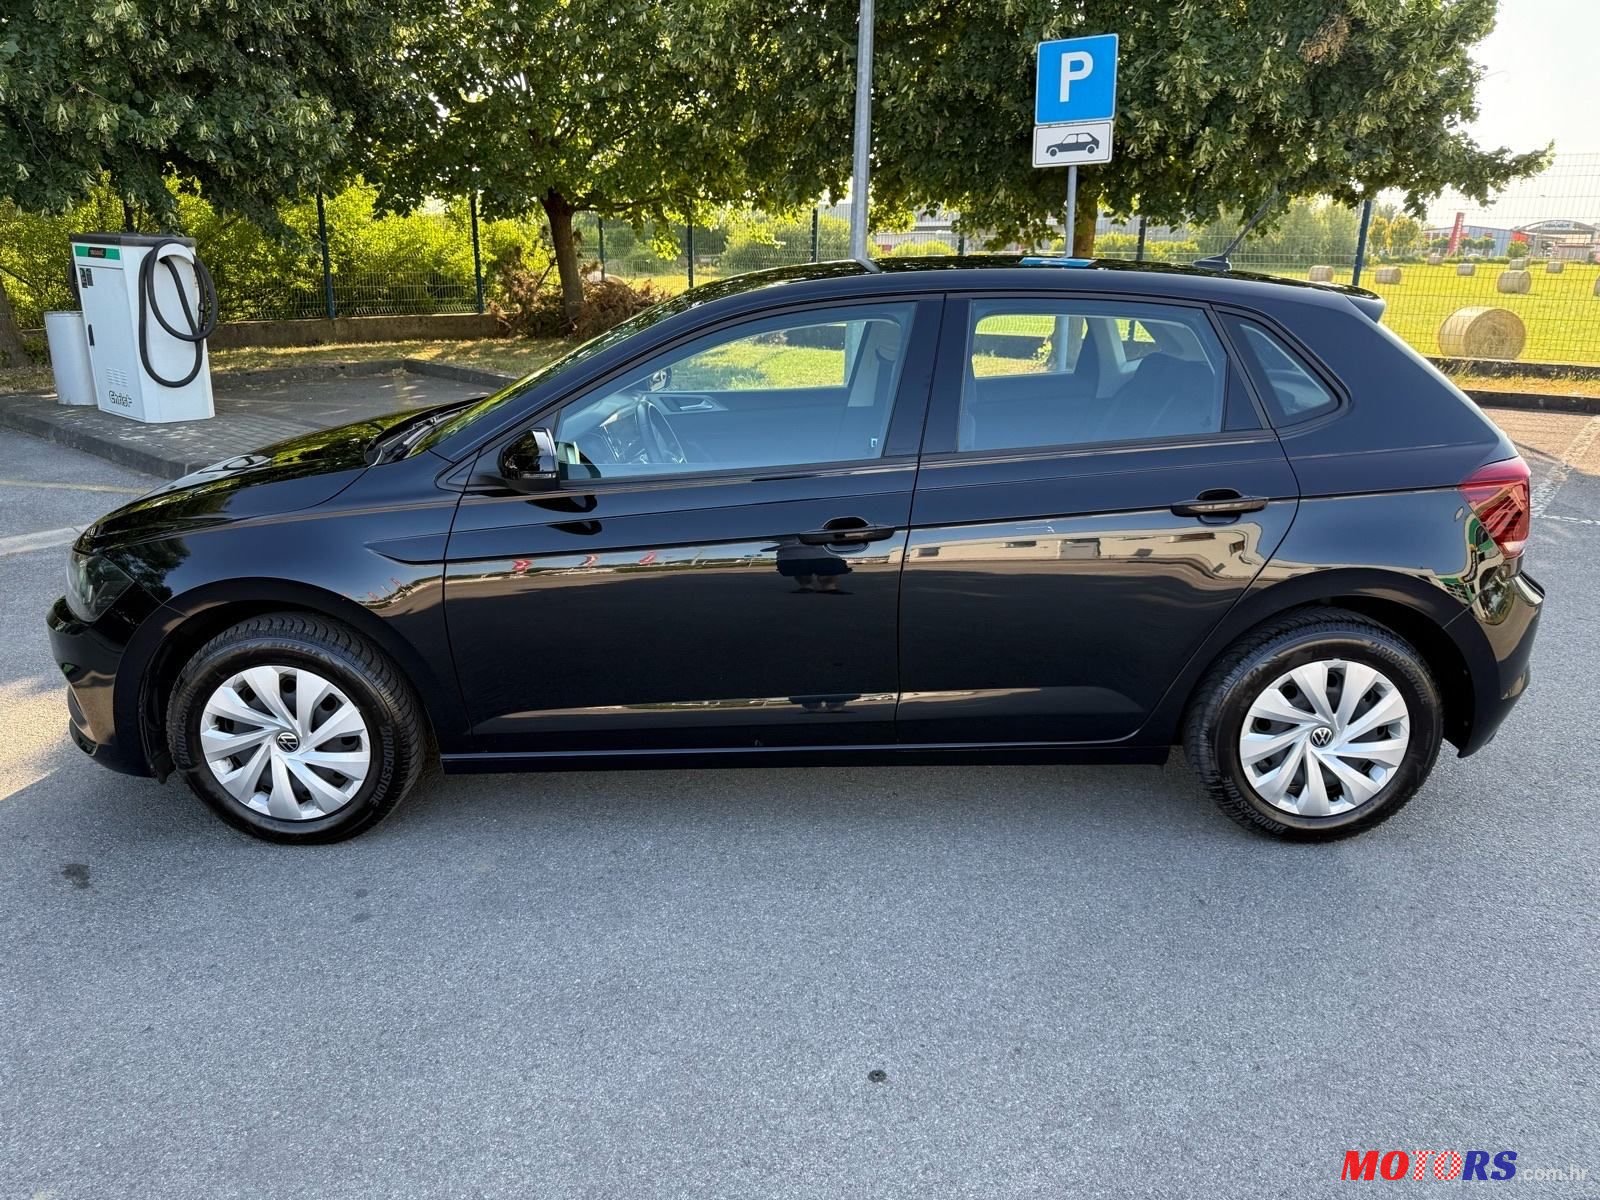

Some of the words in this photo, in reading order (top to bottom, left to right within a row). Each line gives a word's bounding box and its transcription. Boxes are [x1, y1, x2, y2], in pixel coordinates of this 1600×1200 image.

[1059, 50, 1094, 103] P
[369, 724, 395, 807] BRIDGESTONE
[1222, 776, 1288, 834] BRIDGESTONE
